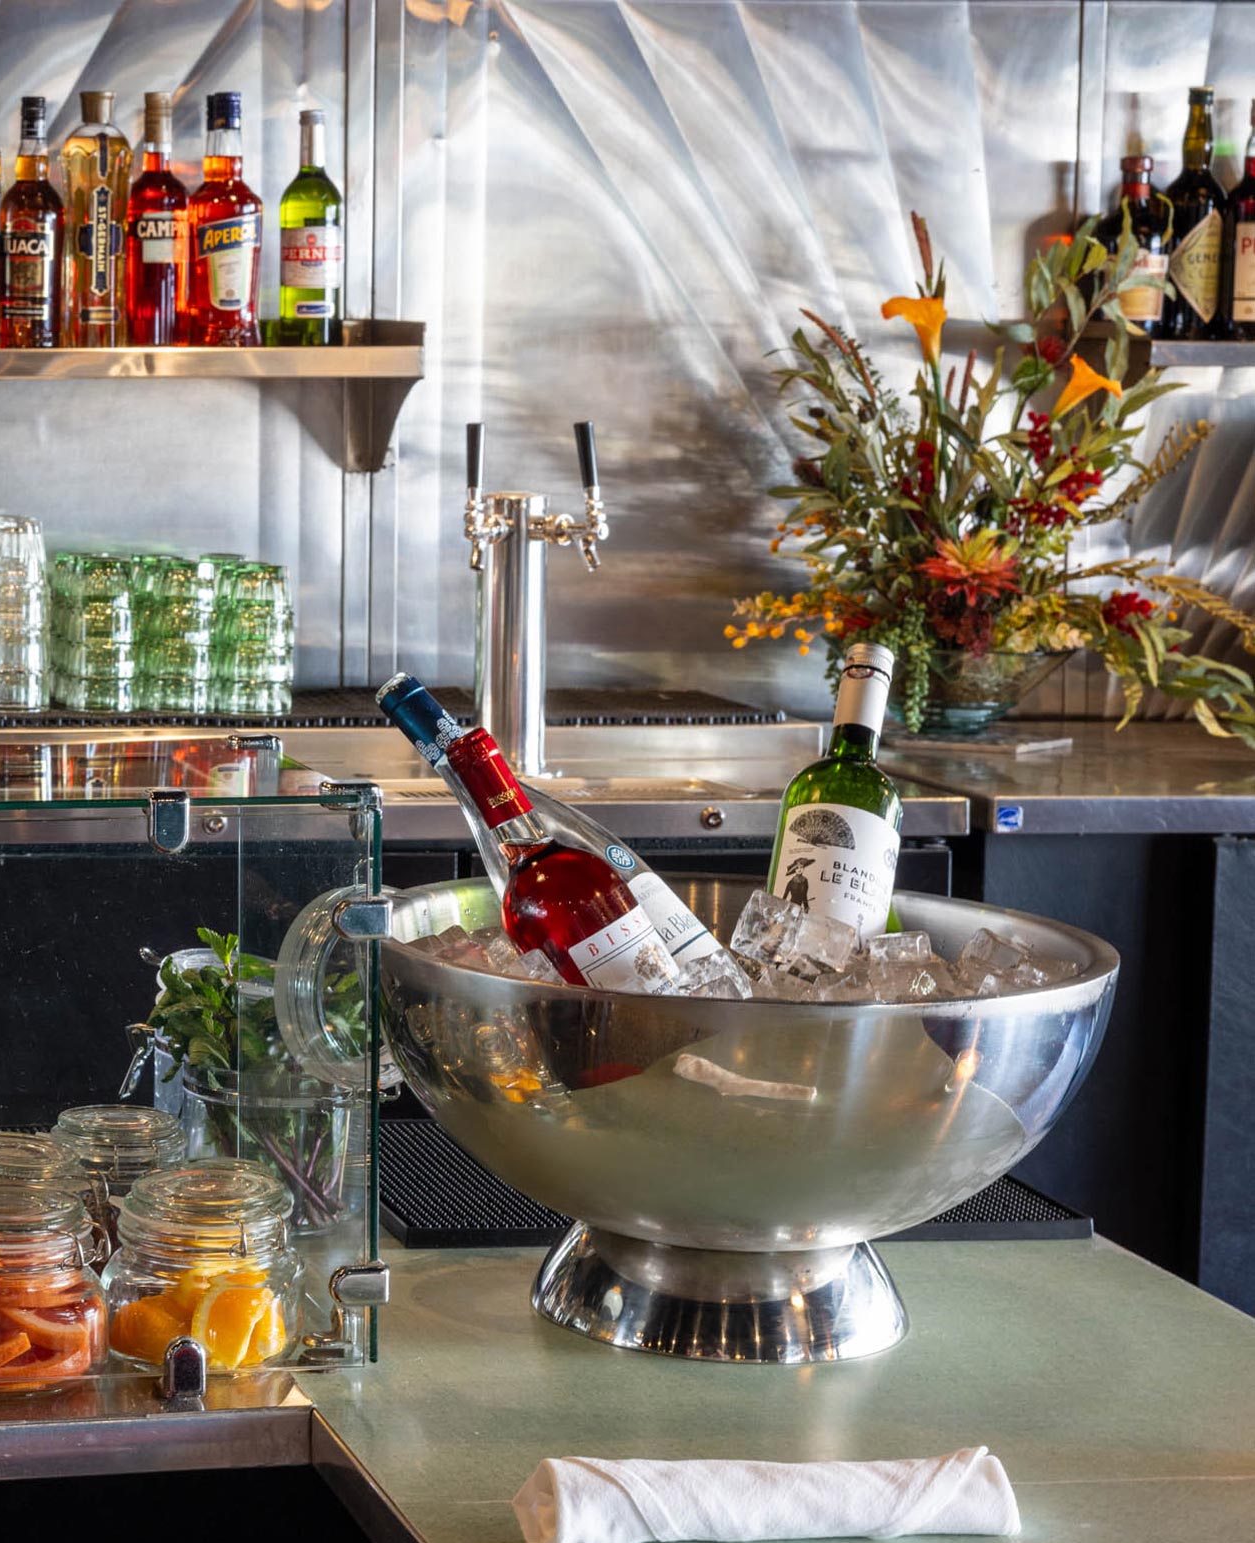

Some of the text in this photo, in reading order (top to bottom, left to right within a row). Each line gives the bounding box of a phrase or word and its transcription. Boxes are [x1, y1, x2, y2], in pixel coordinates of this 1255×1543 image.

[137, 220, 188, 238] CAMPA
[203, 223, 257, 249] APEROL
[6, 238, 48, 254] UACA
[832, 860, 877, 882] BLAND
